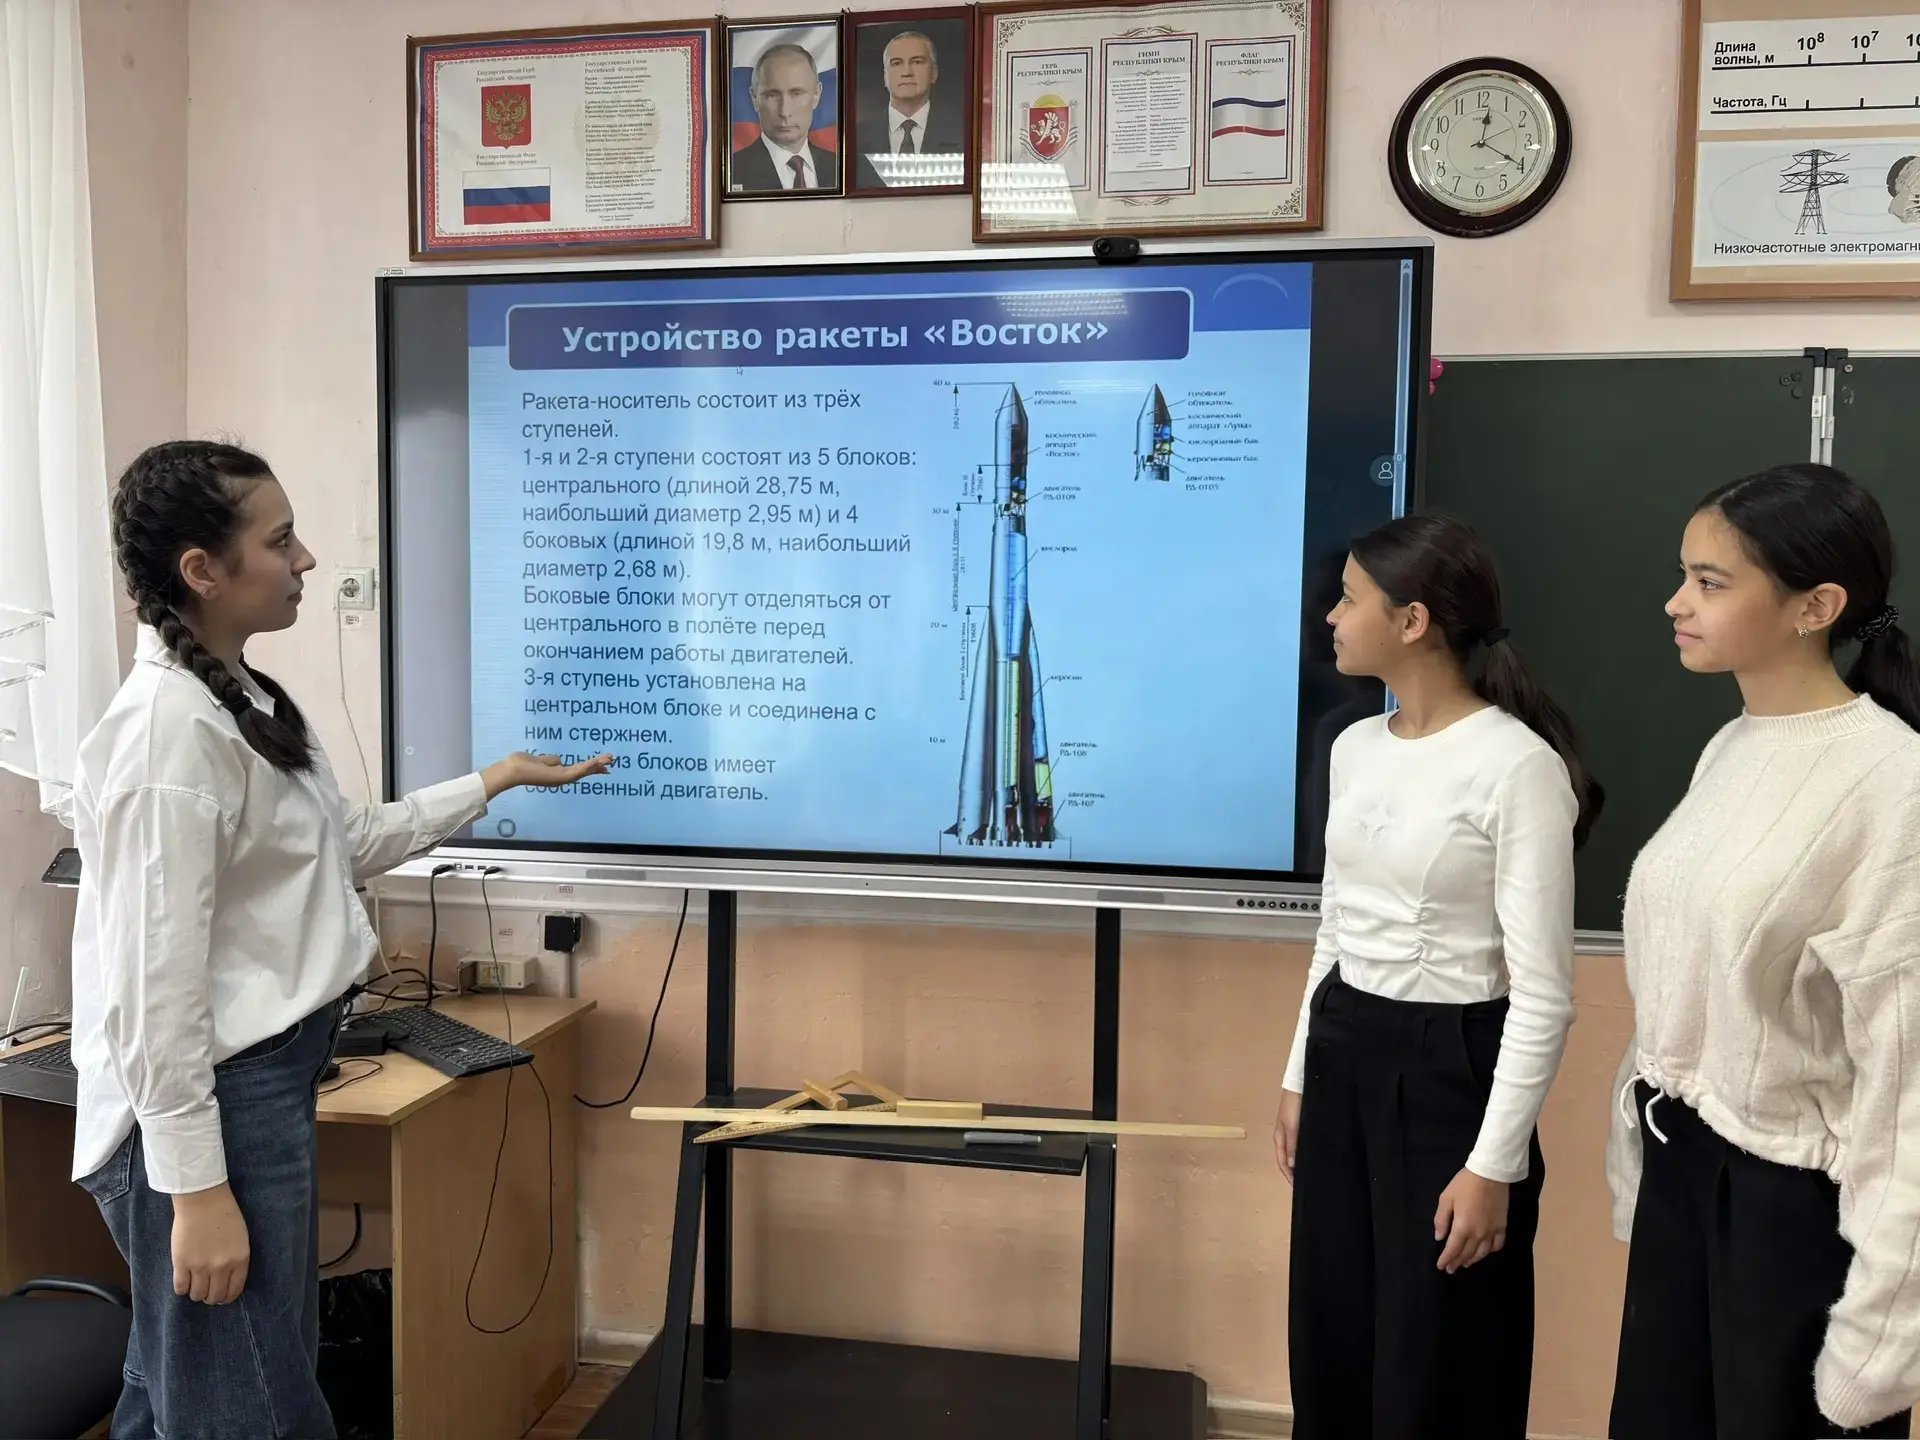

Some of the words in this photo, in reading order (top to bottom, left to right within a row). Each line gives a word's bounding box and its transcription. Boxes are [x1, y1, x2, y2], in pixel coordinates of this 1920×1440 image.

[1714, 41, 1756, 54] Длина
[1112, 58, 1161, 66] РЕСПУБЛИКИ
[1714, 55, 1761, 66] волны,
[1765, 55, 1774, 63] м
[1017, 69, 1061, 77] РЕСПУБЛИКИ
[1454, 98, 1464, 115] 11
[1476, 91, 1490, 108] 12
[1504, 96, 1509, 112] 1
[1713, 96, 1767, 109] Частота,
[1772, 94, 1787, 108] Гц
[1436, 116, 1449, 134] 10
[1518, 111, 1527, 128] 2
[1430, 138, 1439, 154] 9
[1524, 134, 1532, 150] 3
[1437, 161, 1446, 177] 8
[1516, 156, 1524, 174] 4
[1452, 176, 1461, 193] 7
[1475, 181, 1484, 197] 6
[1499, 174, 1507, 191] 5
[1714, 242, 1826, 255] Низкочастотные
[1830, 242, 1920, 255] электромагн
[562, 323, 761, 357] Устройство
[777, 327, 907, 355] ракеты
[924, 319, 1108, 345] «Восток»
[523, 393, 690, 409] Ракета-носитель
[698, 395, 777, 408] состоит
[785, 394, 806, 407] из
[814, 389, 860, 412] трёх
[523, 419, 618, 442] ступеней.
[524, 449, 552, 465] 1-я
[560, 453, 569, 465] и
[577, 448, 607, 465] 2-я
[614, 452, 694, 470] ступени
[702, 452, 781, 465] состоят
[789, 452, 810, 465] из
[818, 448, 829, 465] 5
[837, 447, 915, 465] блоков:
[523, 480, 660, 497] центрального
[668, 476, 749, 498] (длиной
[756, 477, 811, 496] 28,75
[820, 481, 839, 497] м,
[524, 503, 648, 521] наибольший
[654, 508, 741, 527] диаметр
[749, 504, 791, 525] 2,95
[799, 504, 820, 527] м)
[829, 509, 839, 523] и
[846, 505, 858, 523] 4
[524, 531, 607, 549] боковых
[614, 532, 694, 553] (длиной
[703, 533, 744, 553] 19,8
[752, 538, 771, 553] м,
[780, 533, 910, 551] наибольший
[523, 563, 607, 581] диаметр
[615, 560, 656, 579] 2,68
[664, 561, 690, 581] м).
[525, 586, 610, 604] Боковые
[617, 587, 674, 605] блоки
[682, 593, 738, 611] могут
[745, 593, 861, 610] отделяться
[869, 595, 891, 609] от
[525, 618, 661, 635] центрального
[669, 620, 678, 633] в
[687, 617, 756, 634] полёте
[765, 622, 825, 639] перед
[524, 645, 643, 660] окончанием
[651, 644, 724, 665] работы
[731, 647, 853, 665] двигателей.
[525, 668, 553, 685] 3-я
[561, 673, 639, 691] ступень
[646, 675, 775, 692] установлена
[783, 677, 805, 691] на
[525, 699, 656, 717] центральном
[664, 698, 721, 716] блоке
[730, 704, 740, 717] и
[748, 705, 857, 721] соединена
[865, 708, 875, 720] с
[526, 726, 562, 740] ним
[569, 728, 672, 745] стержнем.
[609, 755, 631, 769] из
[638, 752, 707, 771] блоков
[715, 759, 776, 773] имеет
[661, 785, 767, 800] двигатель.
